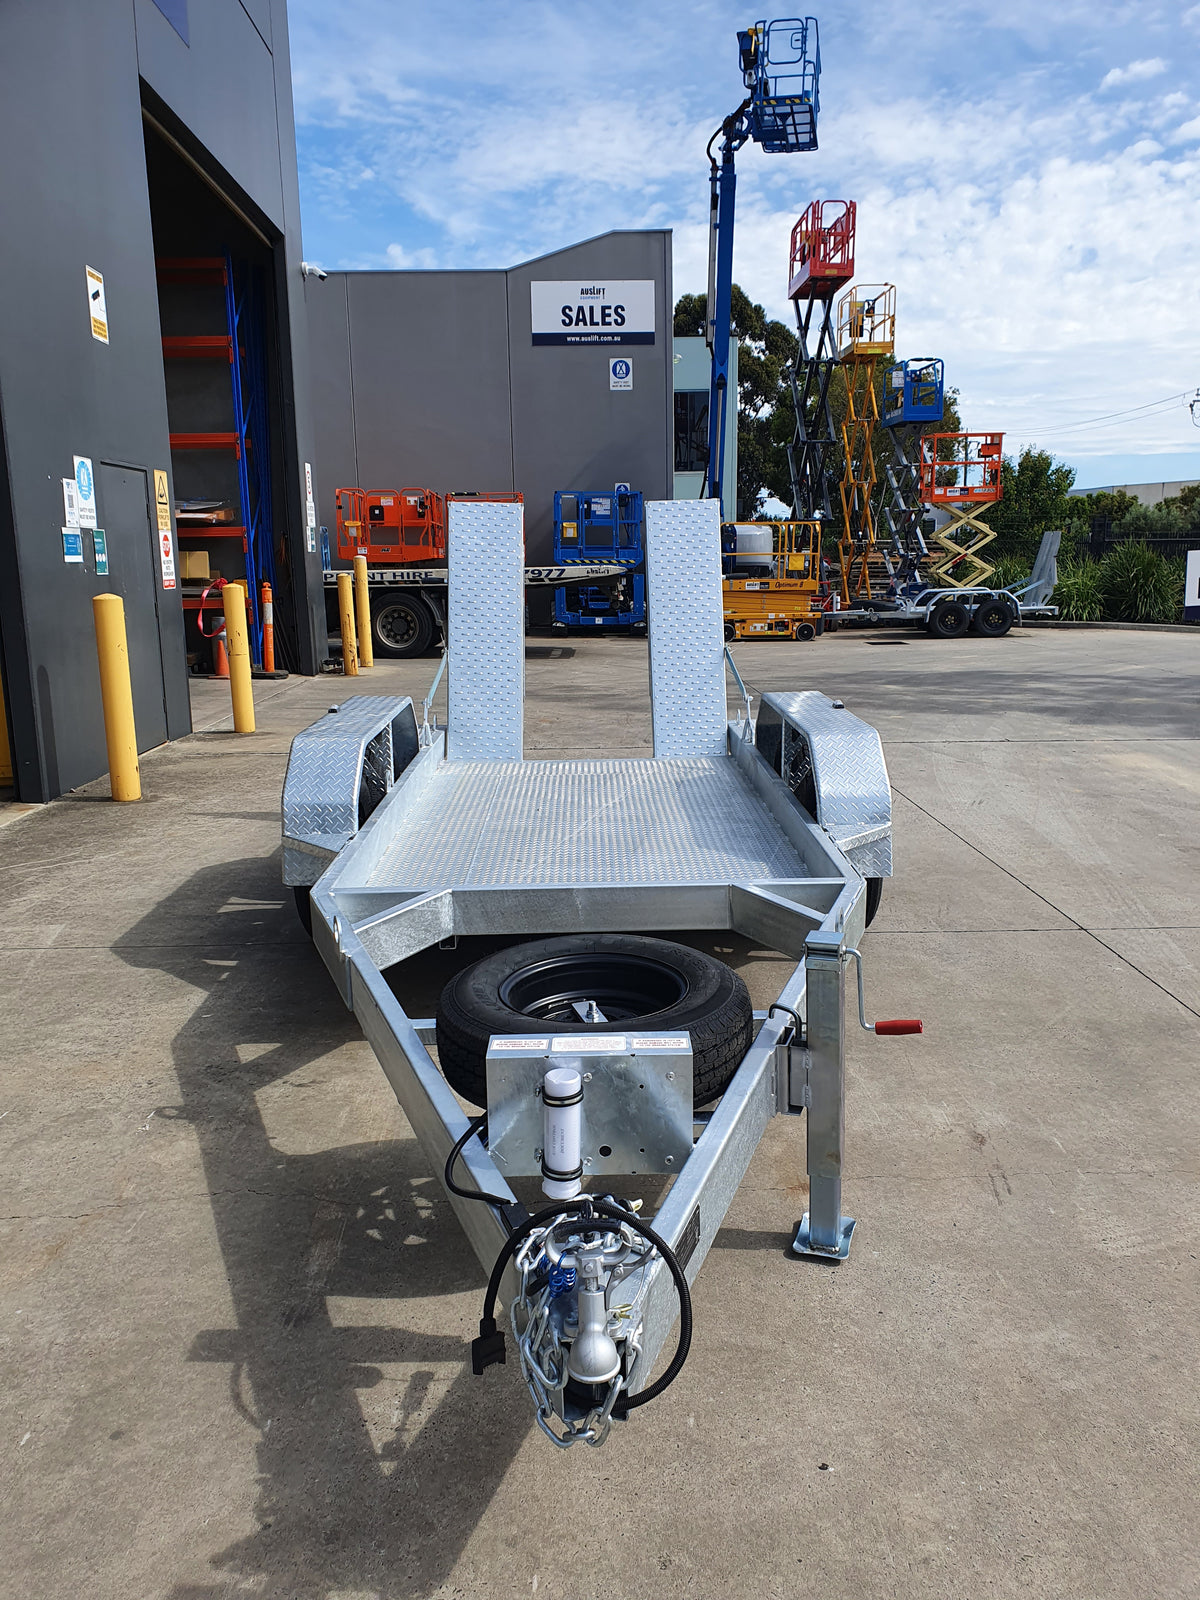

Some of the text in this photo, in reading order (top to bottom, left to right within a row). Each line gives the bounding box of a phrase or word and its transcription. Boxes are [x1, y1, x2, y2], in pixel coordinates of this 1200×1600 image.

[580, 285, 606, 300] AUSLIFT
[561, 304, 626, 327] SALES
[566, 334, 621, 342] www.auslift.com.au
[324, 572, 387, 581] PNT
